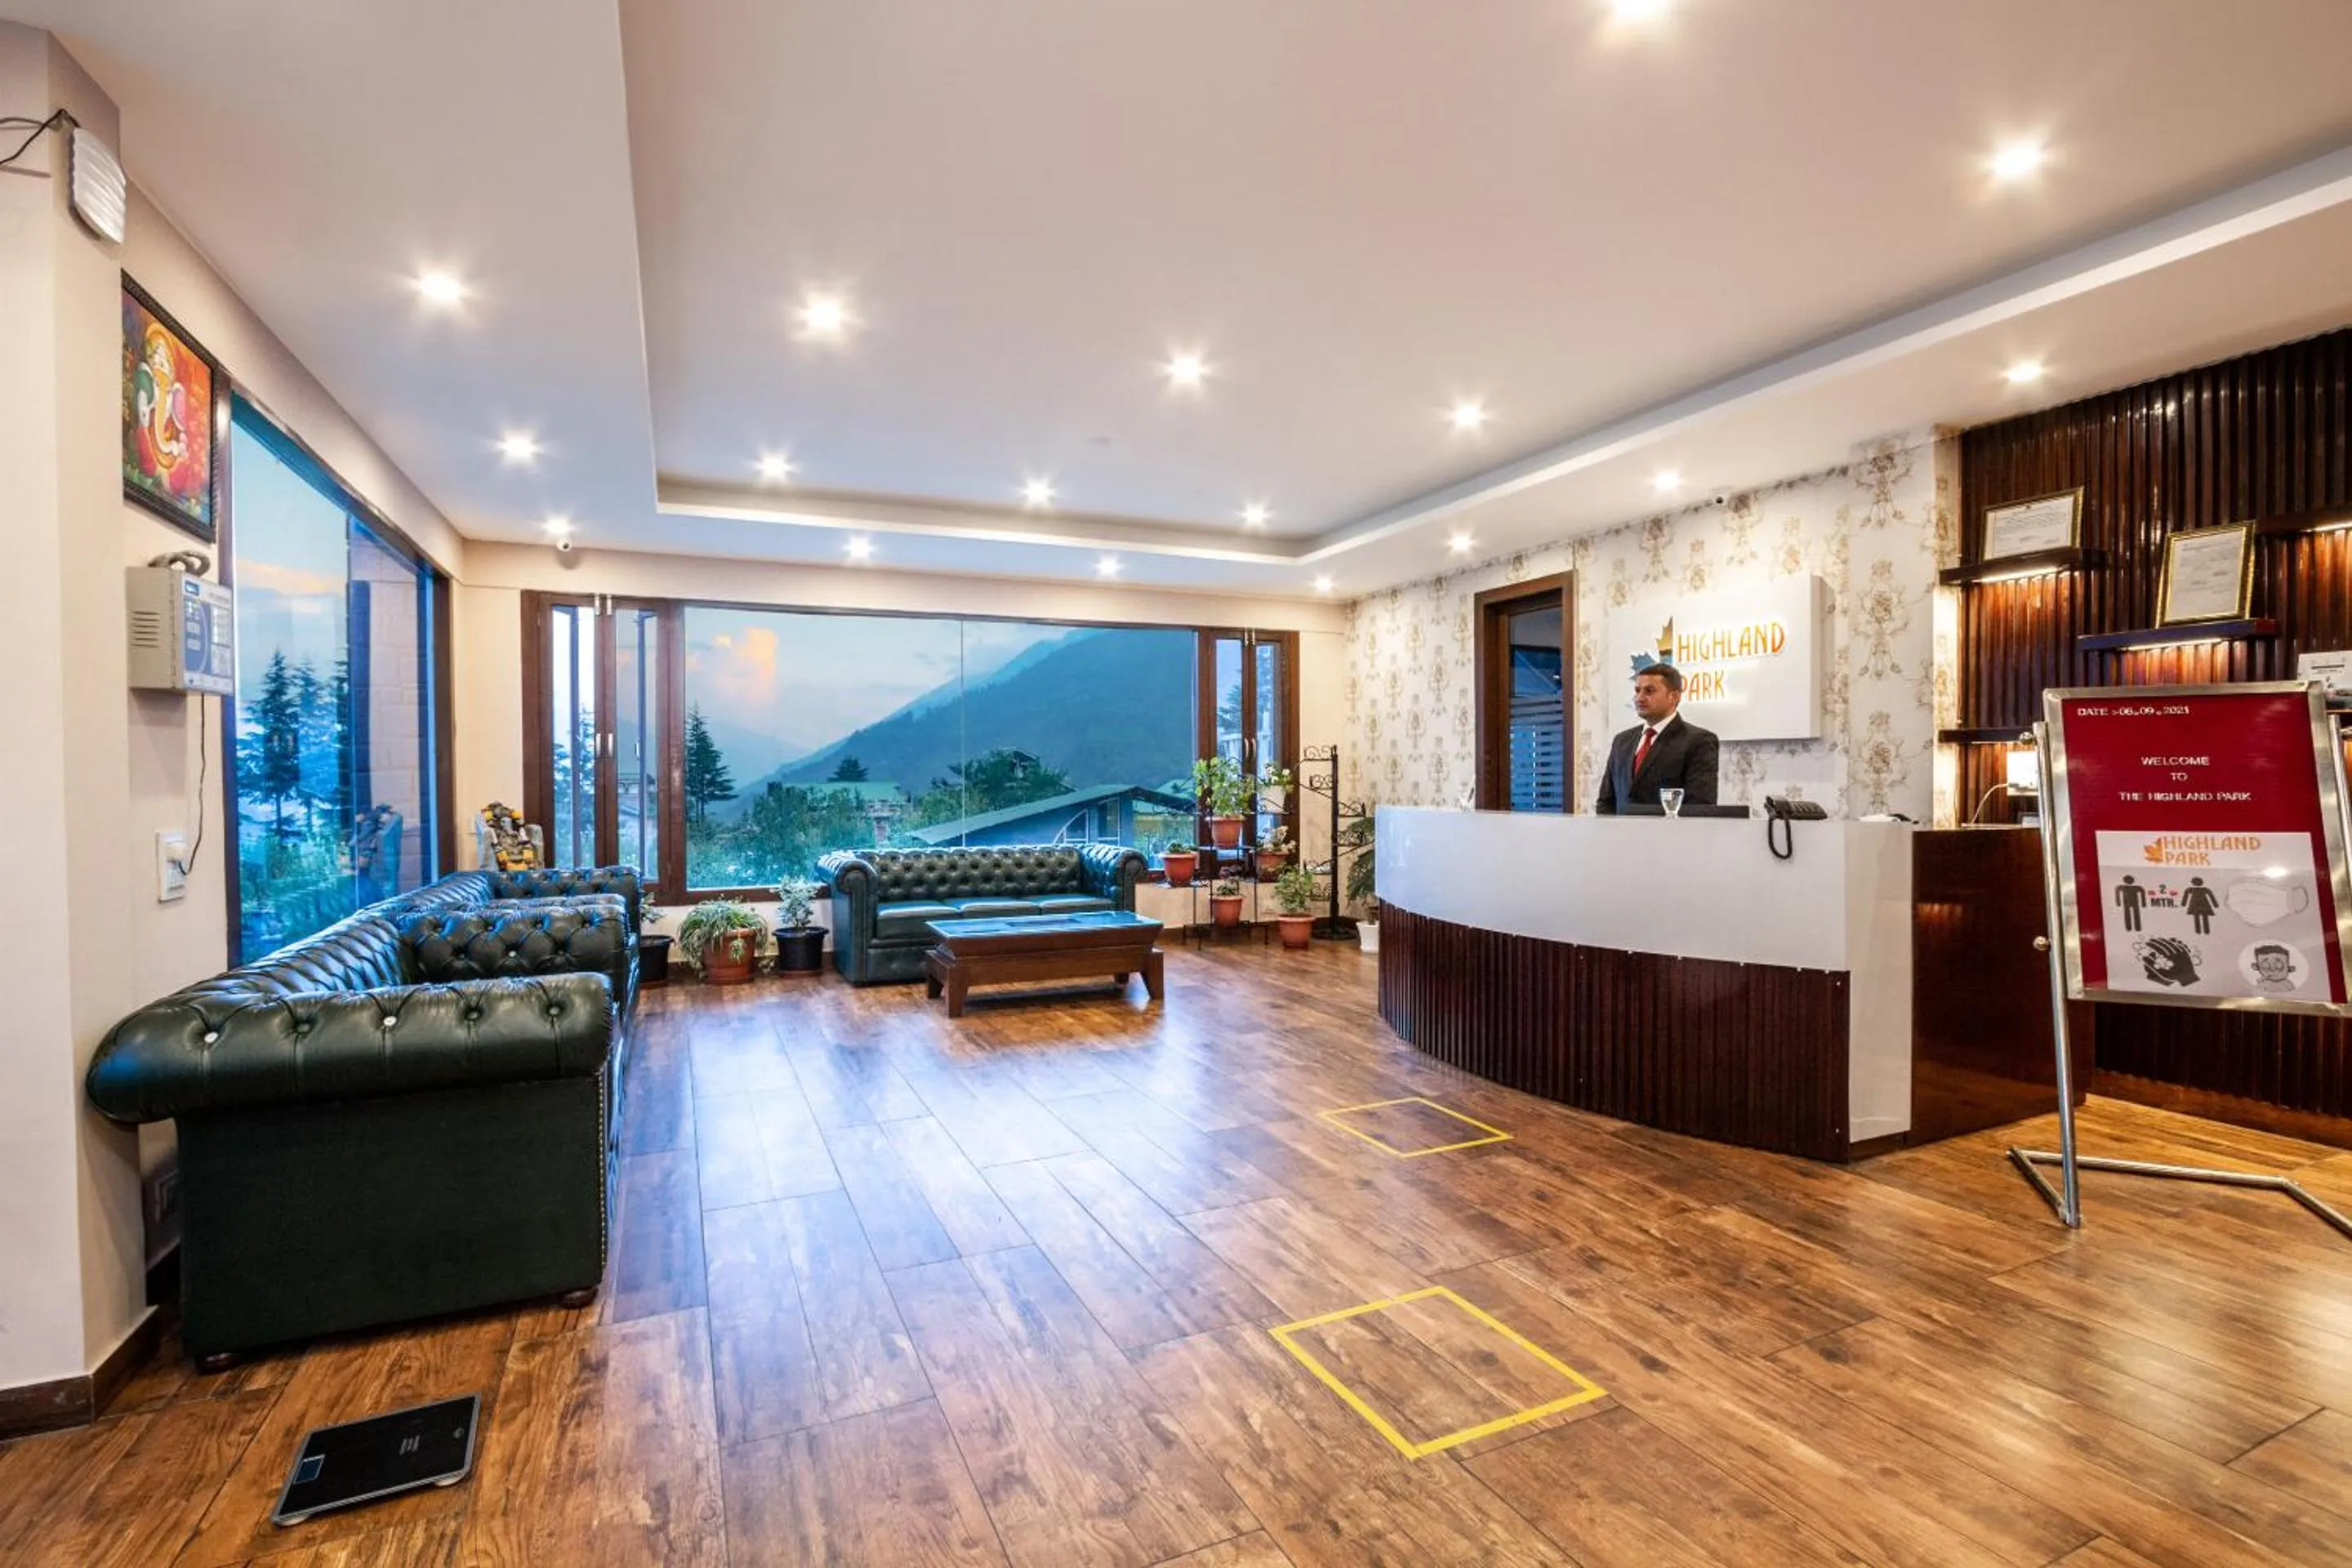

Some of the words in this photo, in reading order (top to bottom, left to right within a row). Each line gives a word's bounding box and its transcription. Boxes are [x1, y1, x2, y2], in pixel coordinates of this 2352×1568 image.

[1677, 621, 1785, 663] HIGHLAND
[1679, 670, 1725, 702] PARK
[2077, 708, 2109, 716] DATE
[2140, 756, 2211, 766] WELCOME
[2170, 772, 2189, 781] TO
[2118, 791, 2144, 801] THE
[2148, 791, 2213, 801] HIGHLAND
[2216, 791, 2252, 801] PARK
[2164, 835, 2261, 851] HIGHLAND
[2165, 851, 2212, 866] PARK
[2158, 884, 2167, 895] 2
